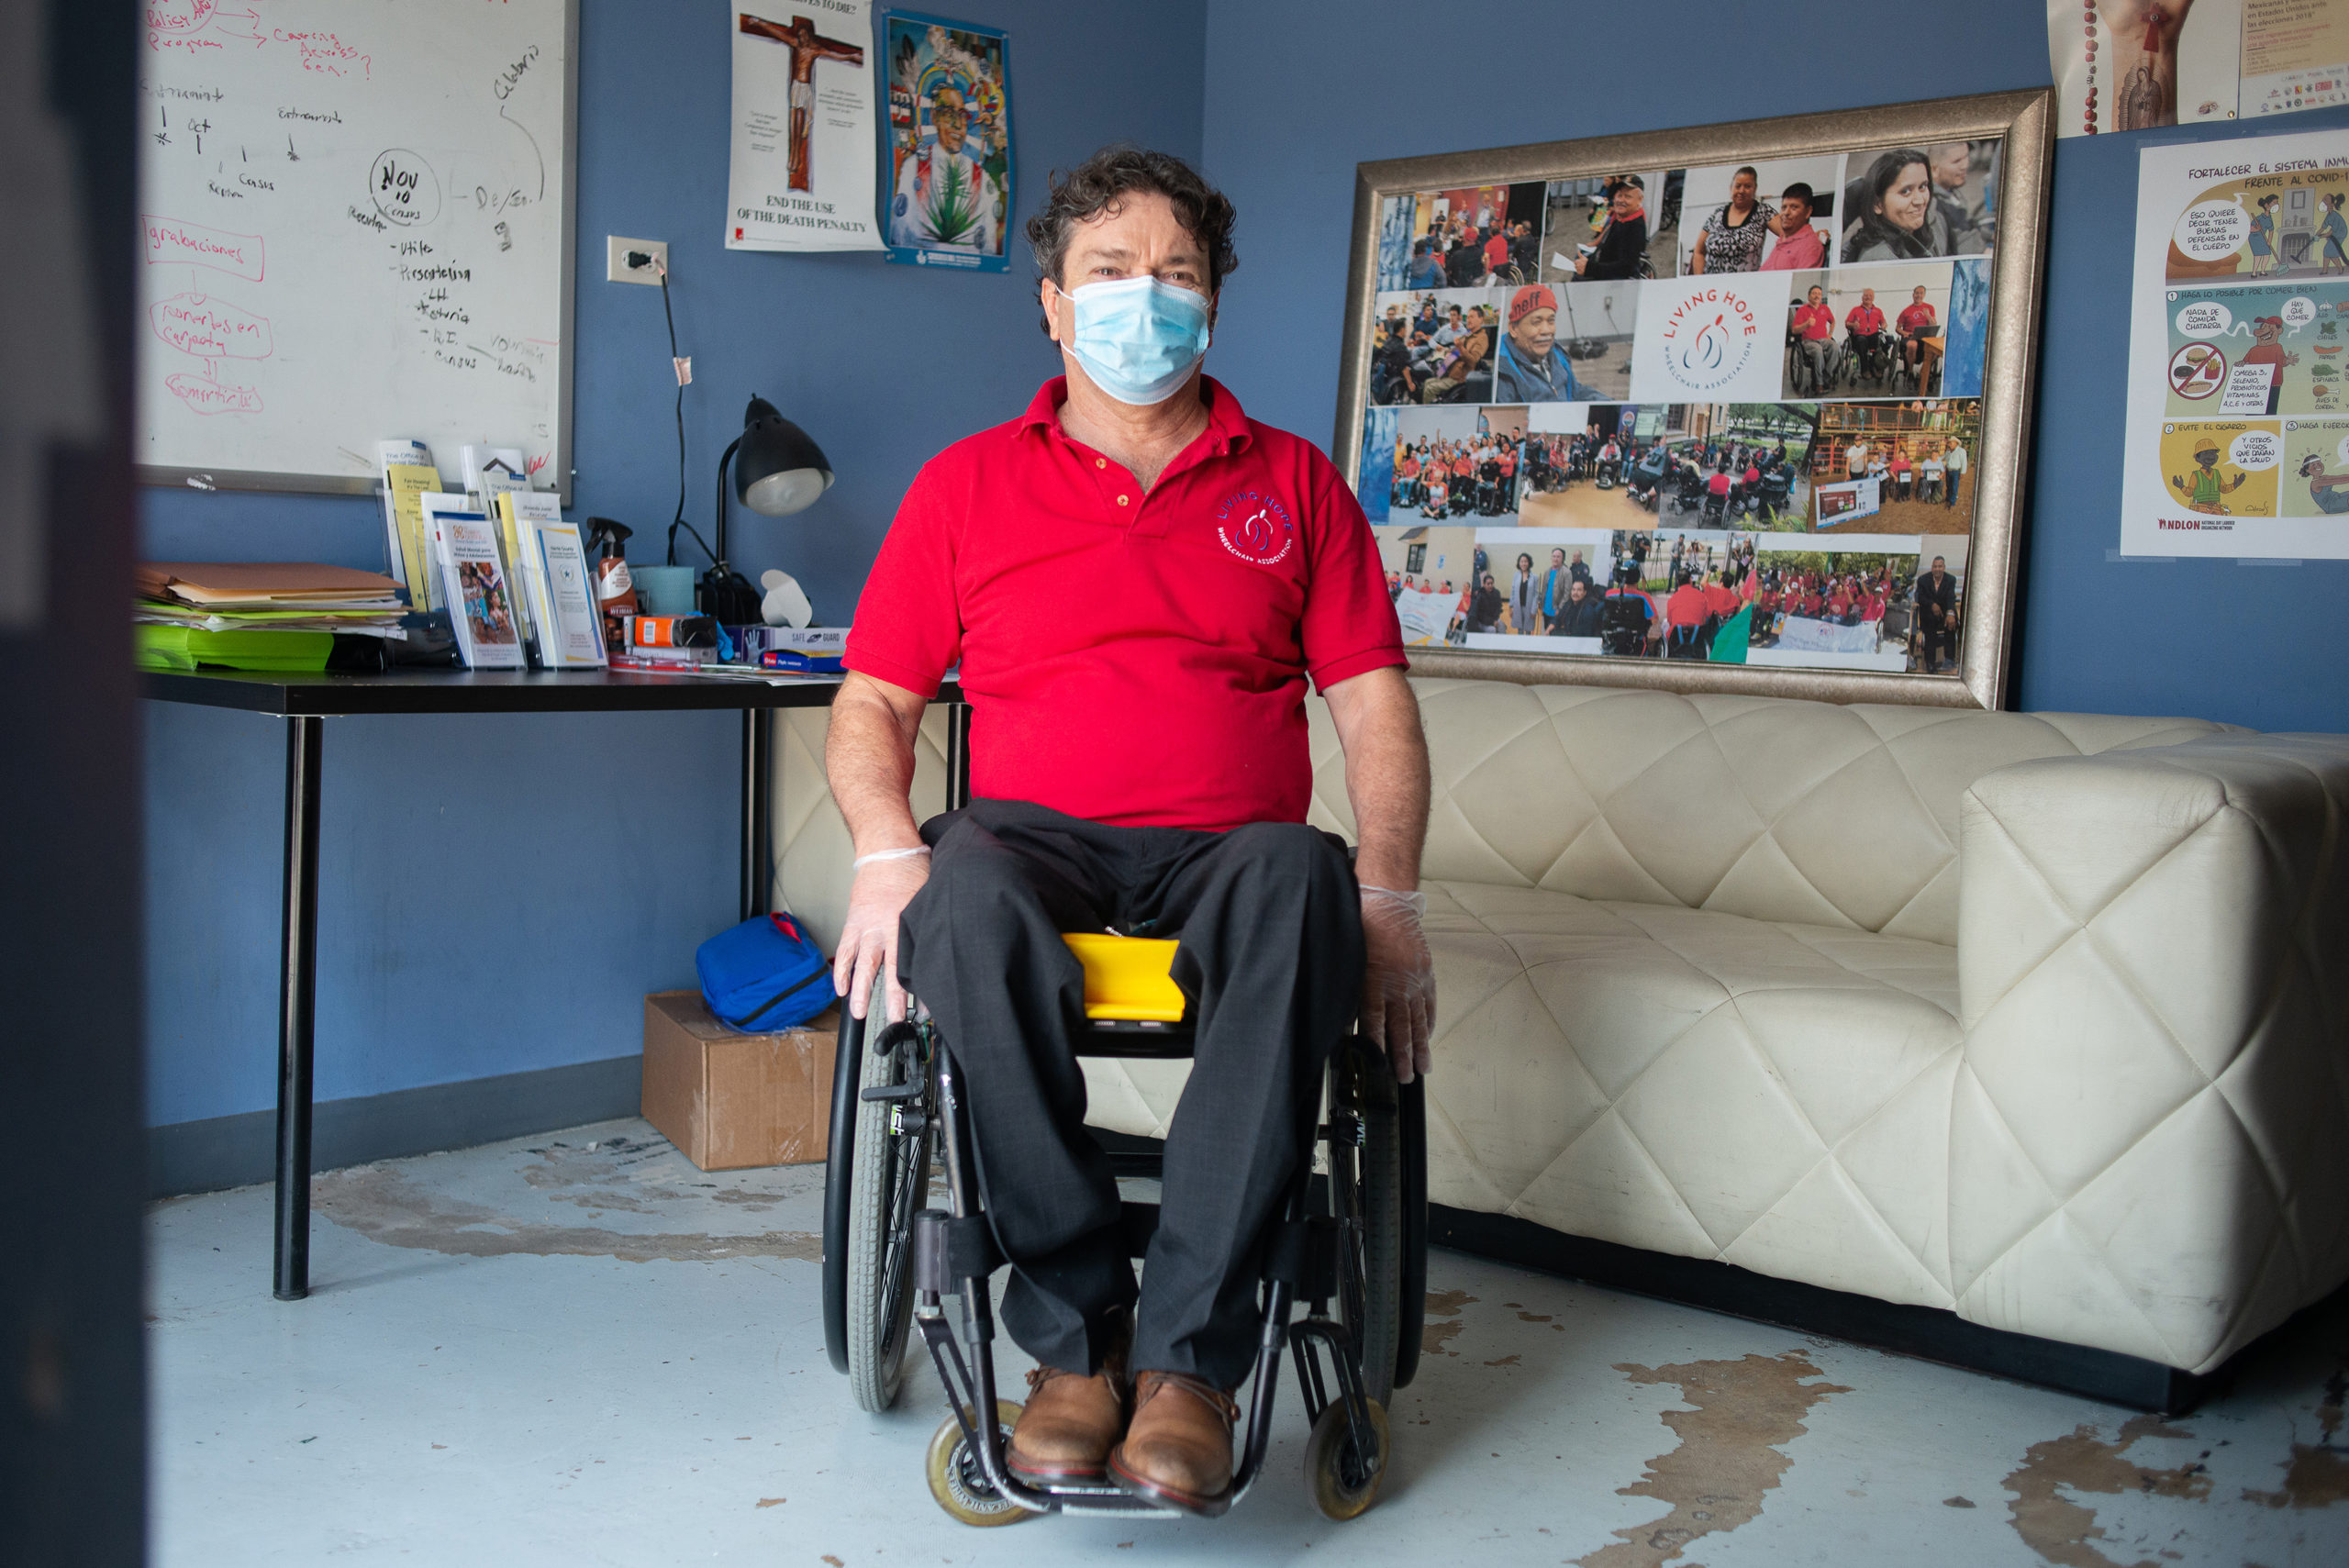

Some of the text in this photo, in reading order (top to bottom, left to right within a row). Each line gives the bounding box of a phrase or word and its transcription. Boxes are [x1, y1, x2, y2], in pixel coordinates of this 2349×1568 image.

[2258, 8, 2284, 18] Estados
[2286, 5, 2310, 13] Unidos
[2258, 17, 2294, 27] elecciones
[188, 118, 211, 133] Oct
[2188, 164, 2251, 179] FORTALECER
[2259, 163, 2270, 172] EL
[2275, 160, 2318, 172] SISTEMA
[2244, 177, 2283, 188] FRENTE
[2290, 176, 2301, 184] AL
[395, 190, 410, 204] 10
[766, 195, 836, 214] END THE USE
[737, 207, 866, 232] OF THE DEATH PENALTY
[2190, 209, 2235, 219] ESO QUIERE
[2196, 227, 2226, 235] BUENAS
[2188, 235, 2226, 243] DEFENSAS
[2203, 242, 2231, 250] CUERPO
[2181, 291, 2201, 300] HAGA
[1514, 291, 1541, 316] neff
[1663, 289, 1756, 339] LIVING HOPE
[1664, 342, 1752, 390] WHEELCHAIR ASSOCIATION
[1217, 491, 1293, 531] LIVING HOPE
[2167, 520, 2200, 530] NDLON
[1218, 527, 1292, 565] WHEELCHAIR ASSOCIATION
[792, 633, 841, 642] SAFE GUARD
